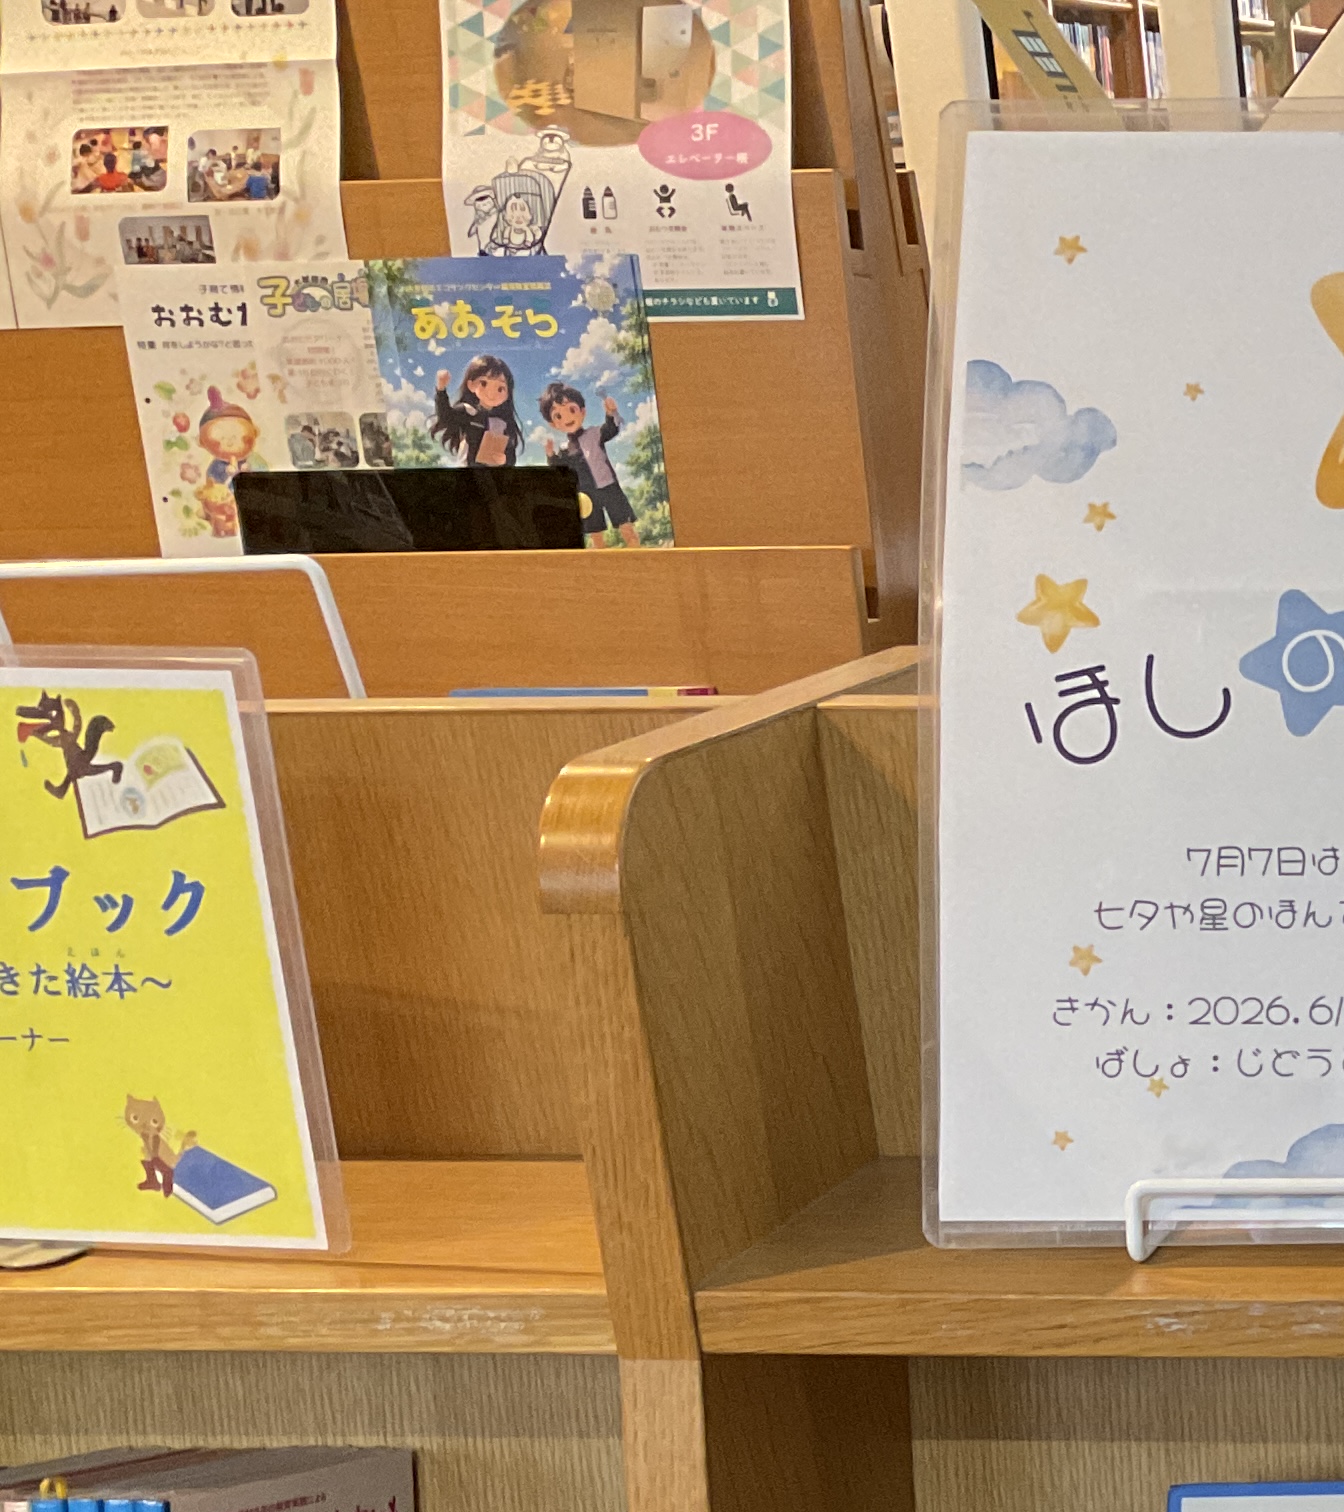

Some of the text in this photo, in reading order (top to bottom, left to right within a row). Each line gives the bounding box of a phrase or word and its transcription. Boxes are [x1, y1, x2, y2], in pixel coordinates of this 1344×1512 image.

[691, 124, 719, 141] 3F
[411, 300, 558, 340] あおぞら
